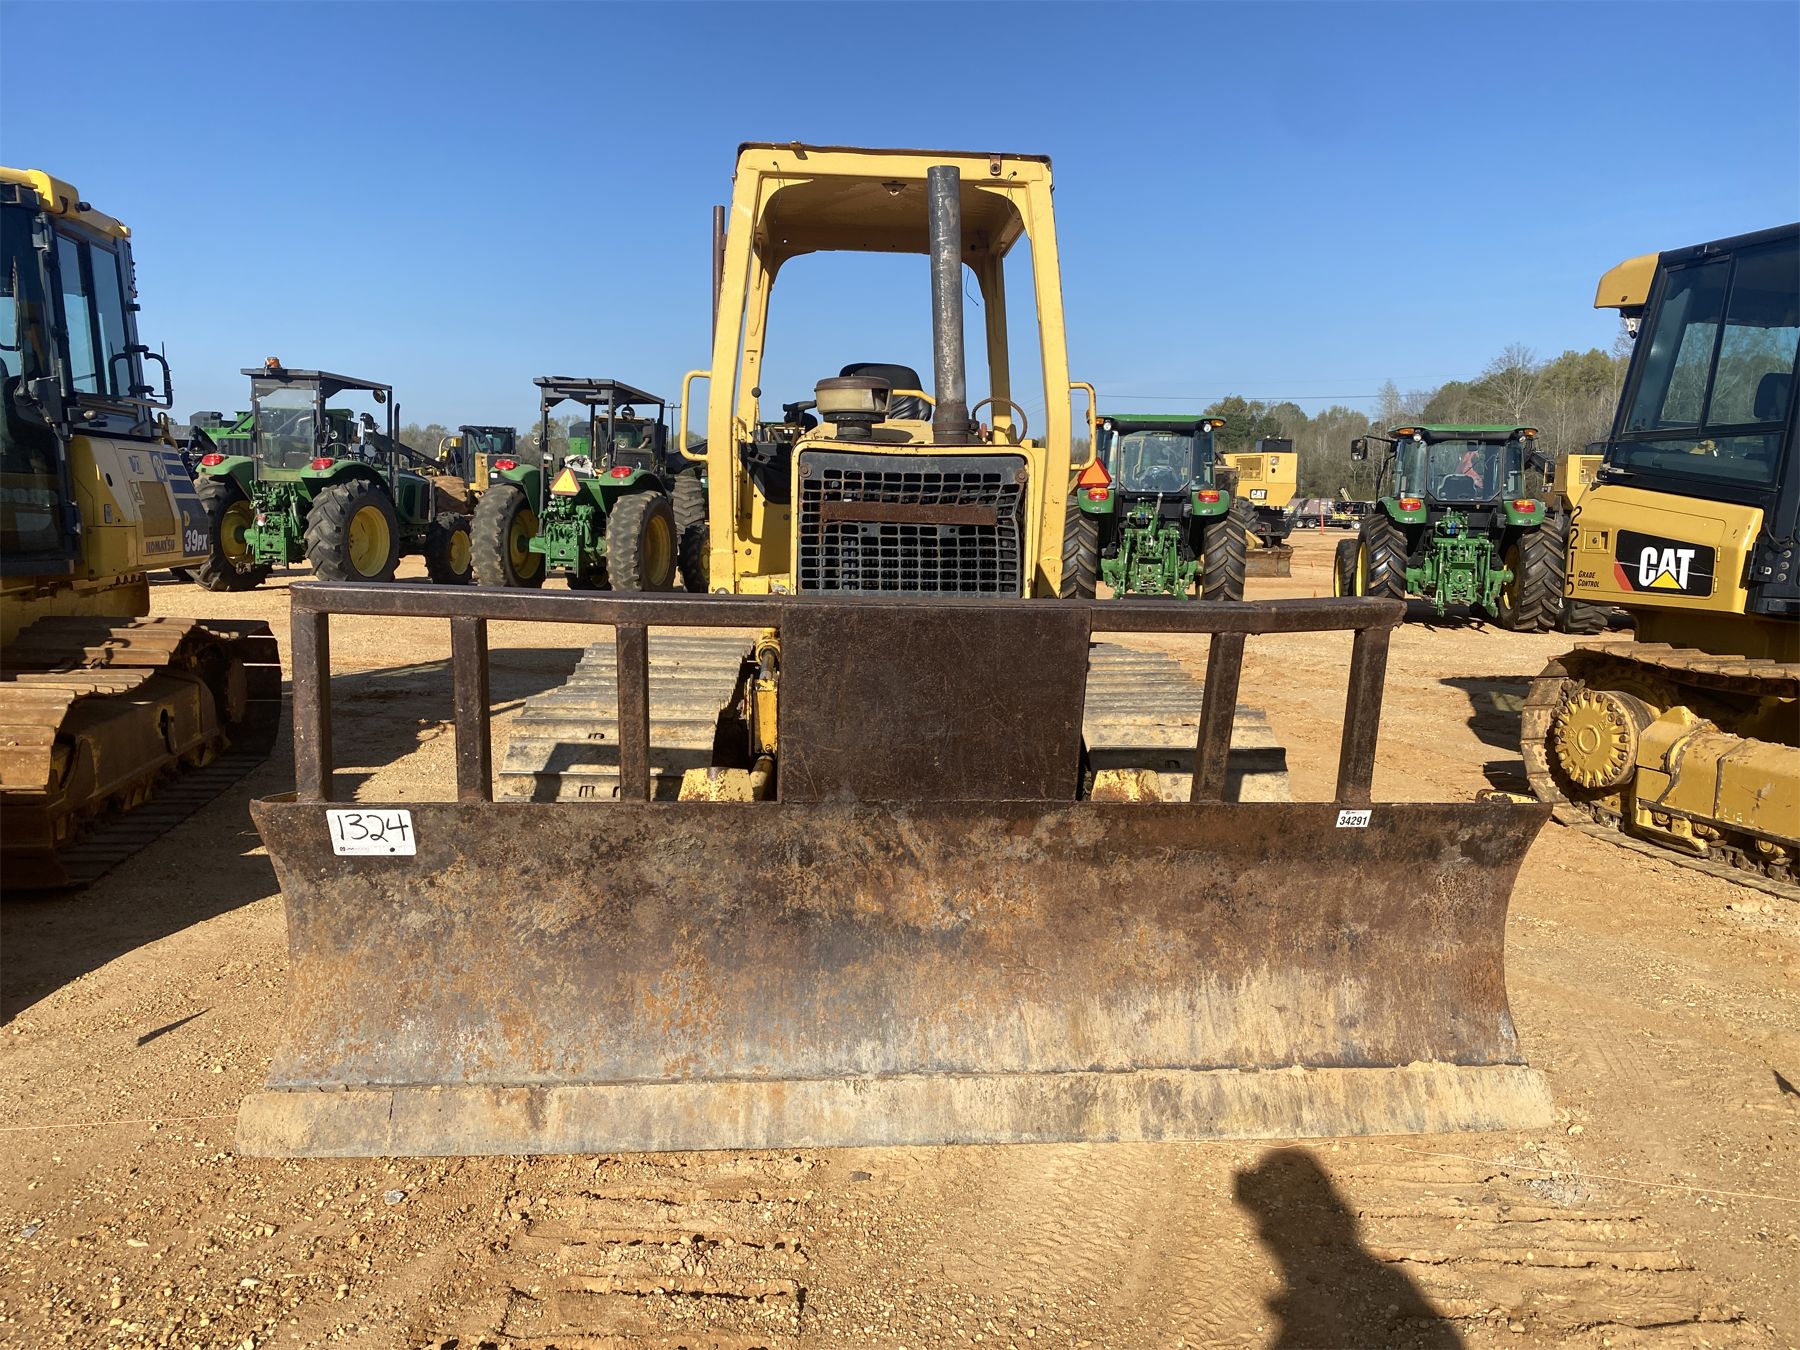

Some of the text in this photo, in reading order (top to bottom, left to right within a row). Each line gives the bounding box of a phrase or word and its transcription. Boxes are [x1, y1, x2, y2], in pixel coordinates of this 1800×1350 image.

[1251, 490, 1266, 499] CAT
[183, 510, 191, 527] D
[145, 536, 175, 554] KOMATSU
[184, 529, 208, 553] 39PX
[1566, 505, 1583, 596] 2215
[1578, 570, 1596, 579] GRADE
[1638, 546, 1696, 590] CAT
[1577, 578, 1600, 588] CONTROL
[337, 813, 409, 843] 1324
[1339, 815, 1368, 826] 34291
